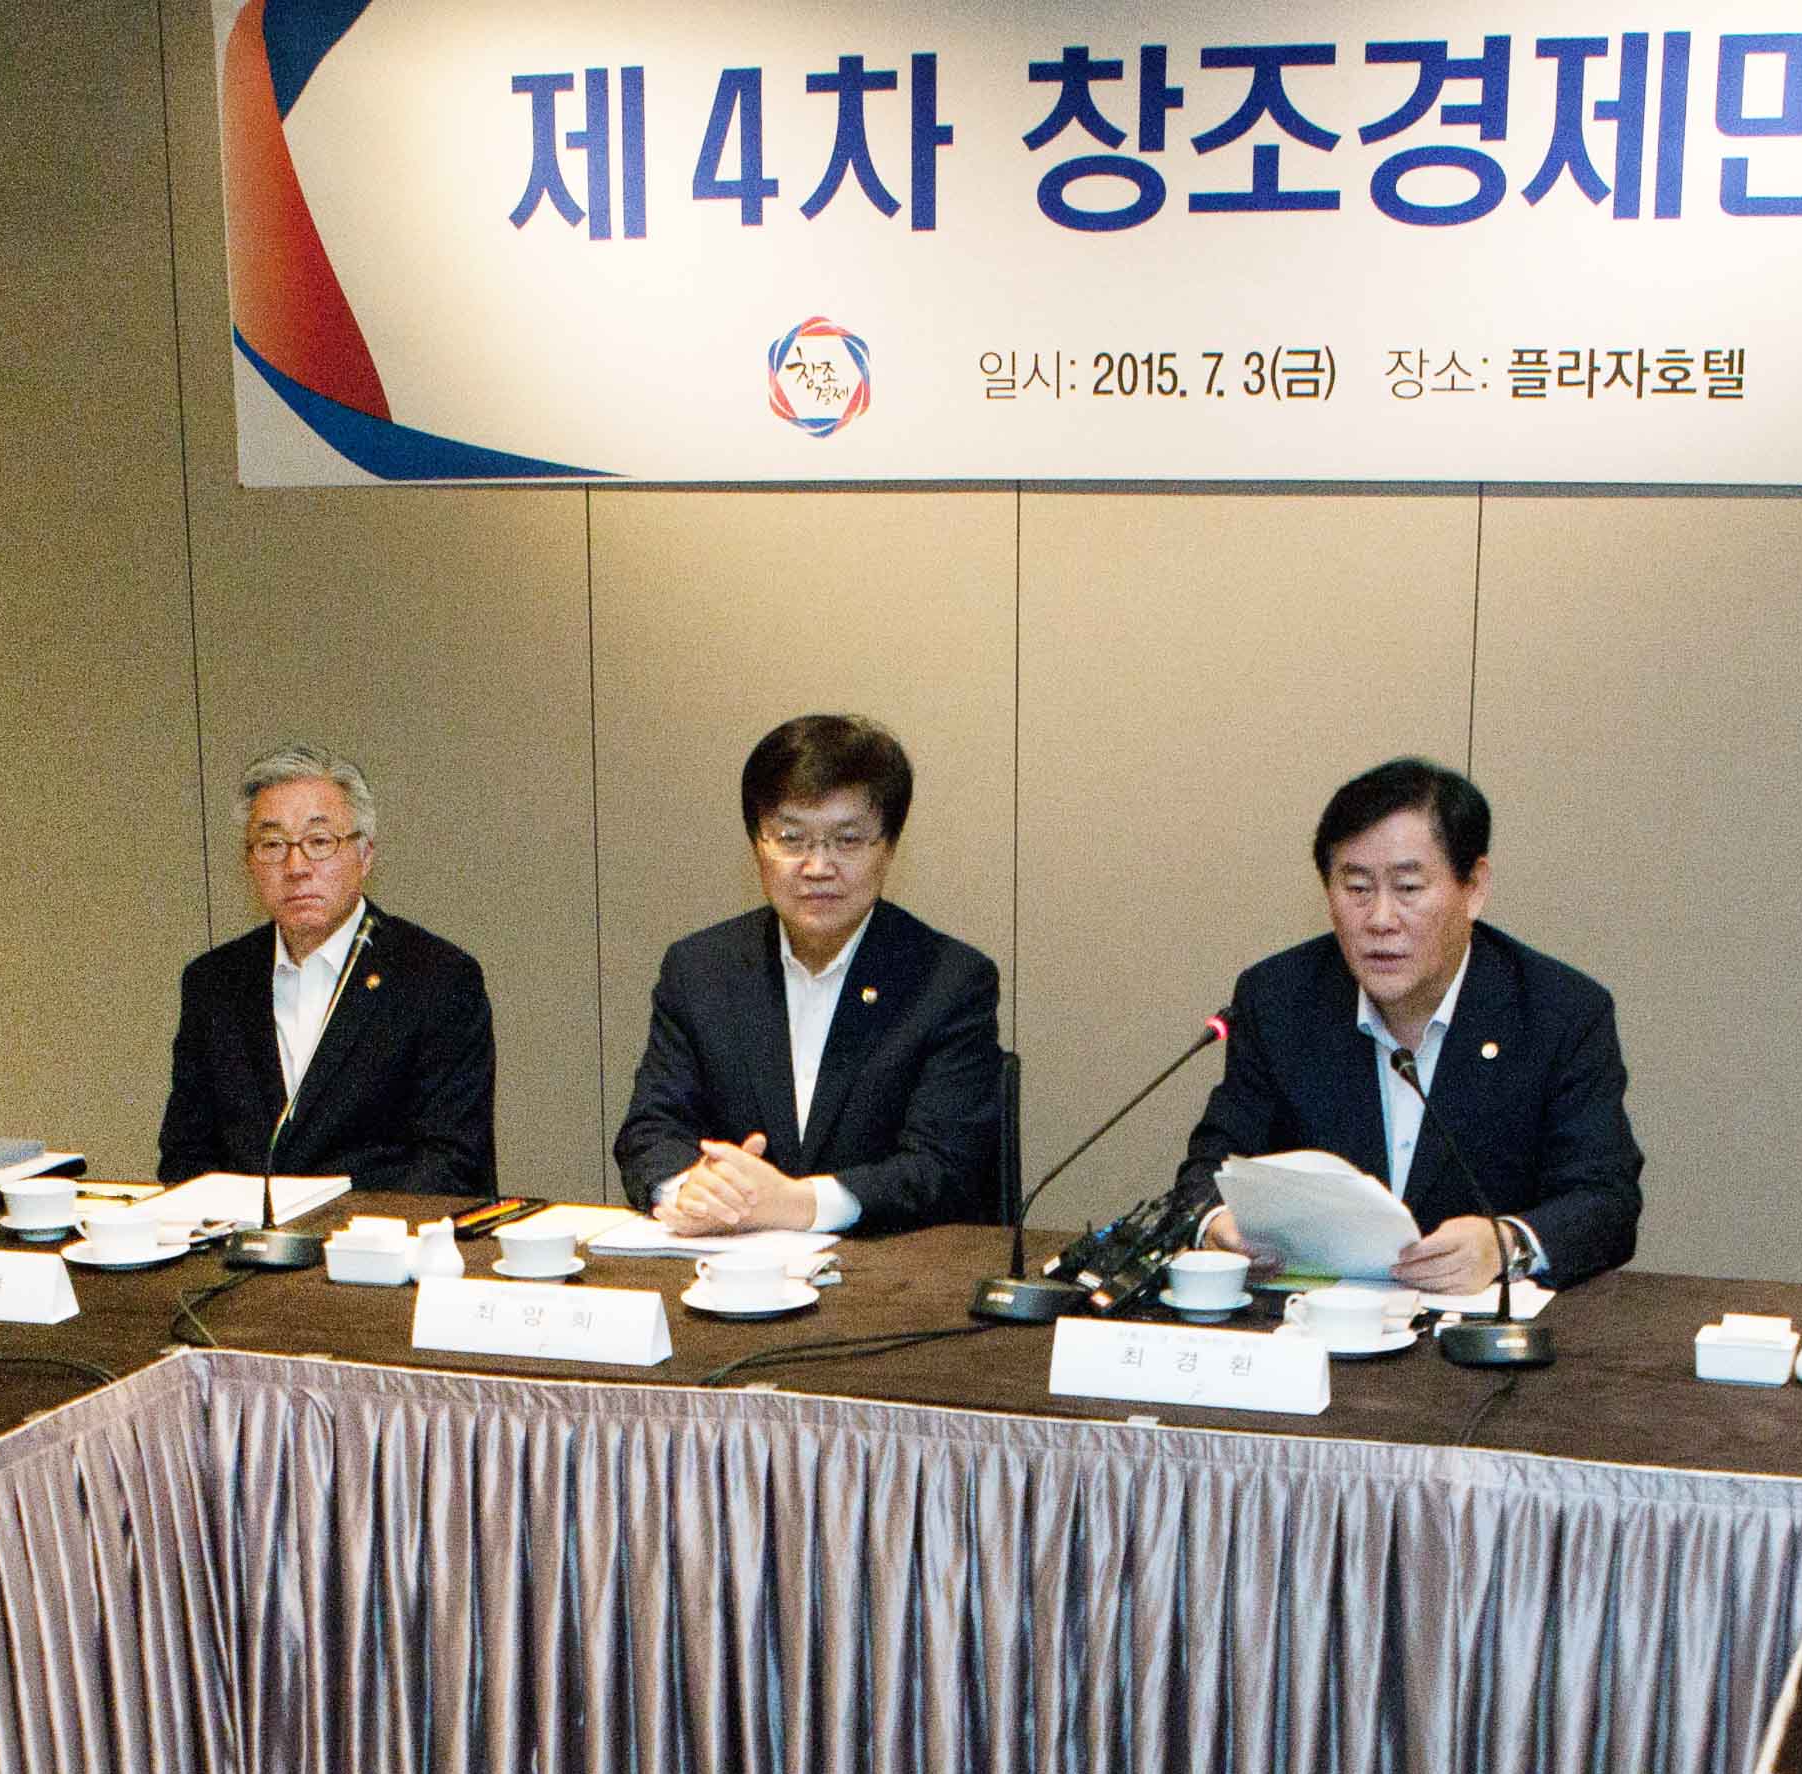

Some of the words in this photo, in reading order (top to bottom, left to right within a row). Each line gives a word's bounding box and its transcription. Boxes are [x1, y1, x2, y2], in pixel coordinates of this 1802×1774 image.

[979, 349, 1077, 400] 일시:
[1092, 352, 1188, 398] 2015.
[1242, 344, 1337, 400] 3(금)
[1384, 347, 1489, 400] 장소:
[1507, 346, 1746, 400] 플라자호텔
